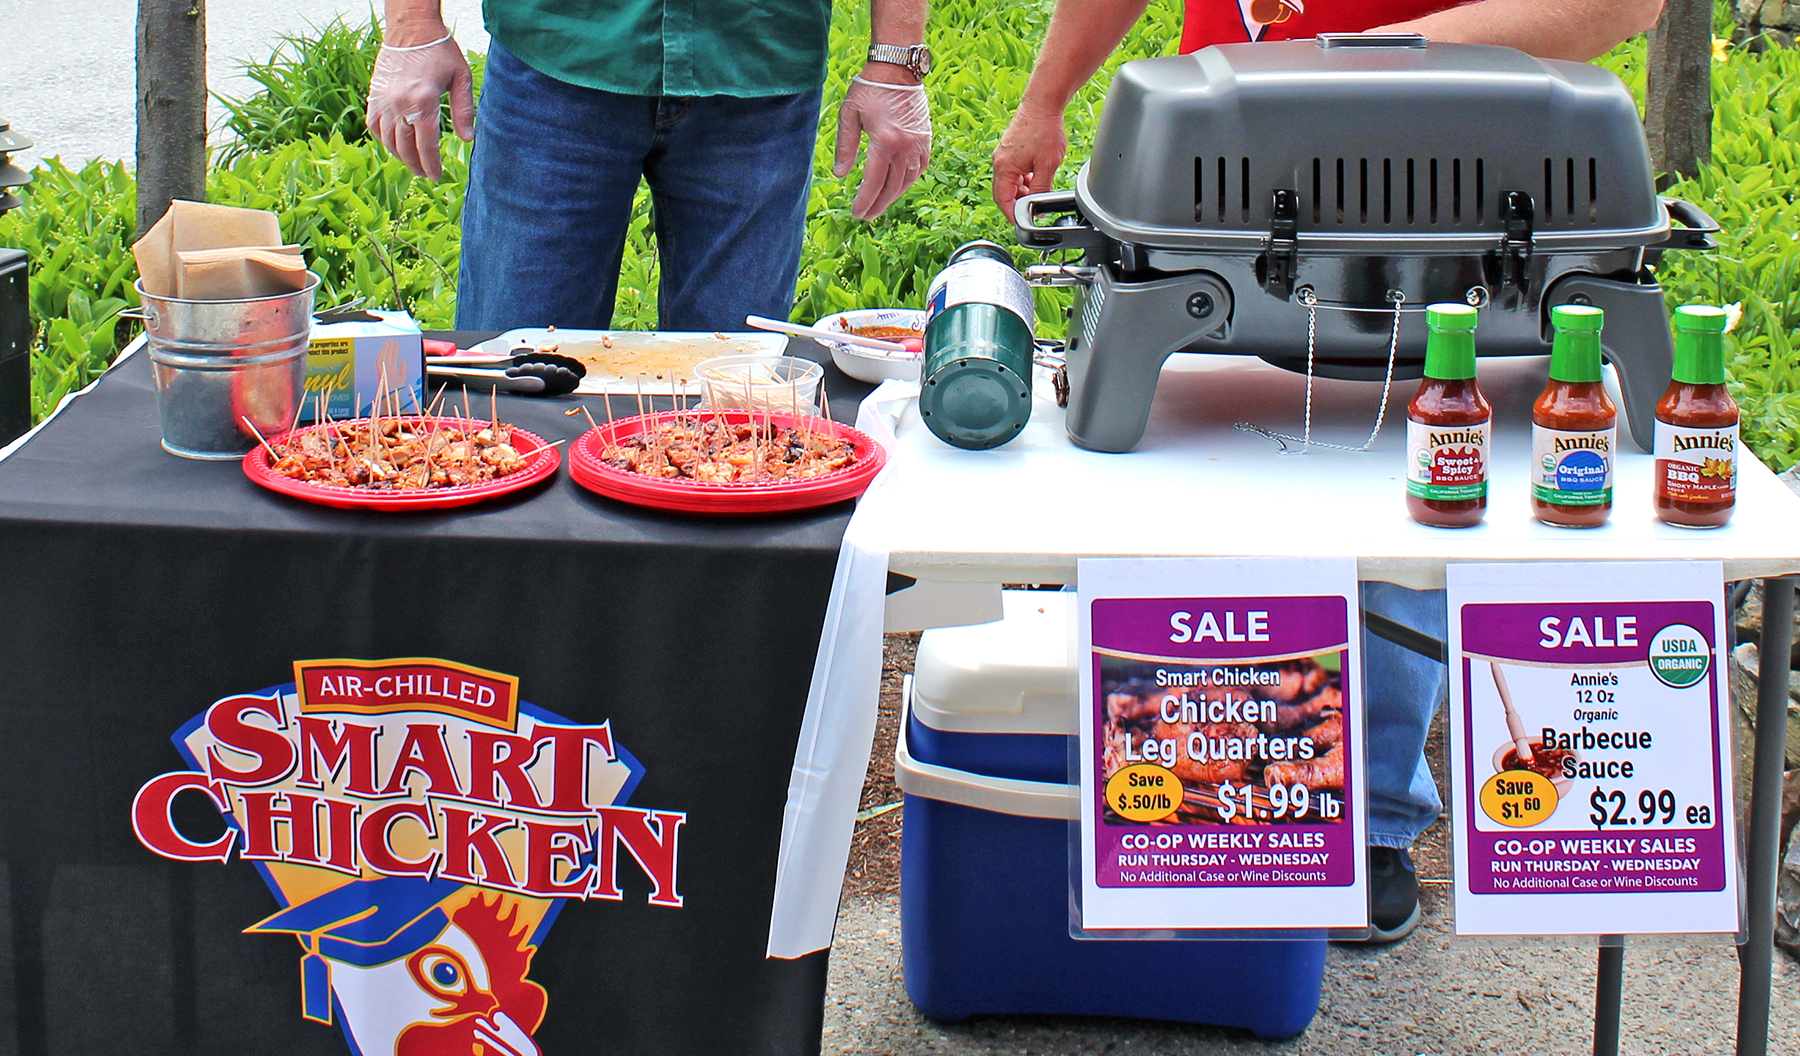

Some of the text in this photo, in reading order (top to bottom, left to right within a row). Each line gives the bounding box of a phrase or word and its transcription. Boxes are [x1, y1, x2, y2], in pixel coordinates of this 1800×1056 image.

[1429, 428, 1485, 449] Annie's
[1554, 433, 1610, 453] Annie's
[1673, 430, 1734, 453] Annie's
[1437, 456, 1473, 466] Sweet
[1667, 462, 1699, 472] ORGANIC
[1442, 465, 1474, 476] Spicy
[1558, 464, 1605, 477] Original
[1667, 469, 1700, 484] BBQ
[1667, 480, 1691, 489] SMOKY
[1169, 611, 1270, 643] SALE
[1538, 616, 1639, 648] SALE
[1661, 639, 1698, 653] USDA
[1658, 657, 1703, 671] ORGANIC
[1155, 667, 1280, 686] Smart Chicken
[1570, 672, 1618, 687] Annie's
[318, 674, 497, 709] AIR-CHILLED
[1576, 690, 1615, 703] 12 Oz
[1160, 693, 1277, 723] Chicken
[1573, 708, 1618, 723] Organic
[1542, 726, 1652, 750] Barbecue
[204, 689, 619, 813] SMART
[1125, 731, 1315, 768] Leg Quarters
[1562, 756, 1634, 779] Sauce
[1128, 772, 1164, 787] Save
[1495, 779, 1533, 795] Save
[1118, 793, 1171, 811] $.50/lb
[1217, 780, 1340, 823] $1.99 lb
[1589, 786, 1711, 831] $2.99 ea
[131, 771, 687, 908] CHICKEN
[1121, 832, 1325, 849] CO-OP WEEKLY SALES
[1494, 838, 1697, 855] CO-OP WEEKLY SALES
[1118, 854, 1149, 866] RUN
[1151, 854, 1228, 866] THURSDAY
[1238, 853, 1329, 866] WEDNESDAY
[1491, 860, 1522, 873] RUN
[1524, 860, 1600, 872] THURSDAY
[1611, 858, 1701, 871] WEDNESDAY
[1120, 869, 1326, 882] No Additional Case or Wine Discounts
[1493, 875, 1698, 888] No Additional Case or Wine Discounts
